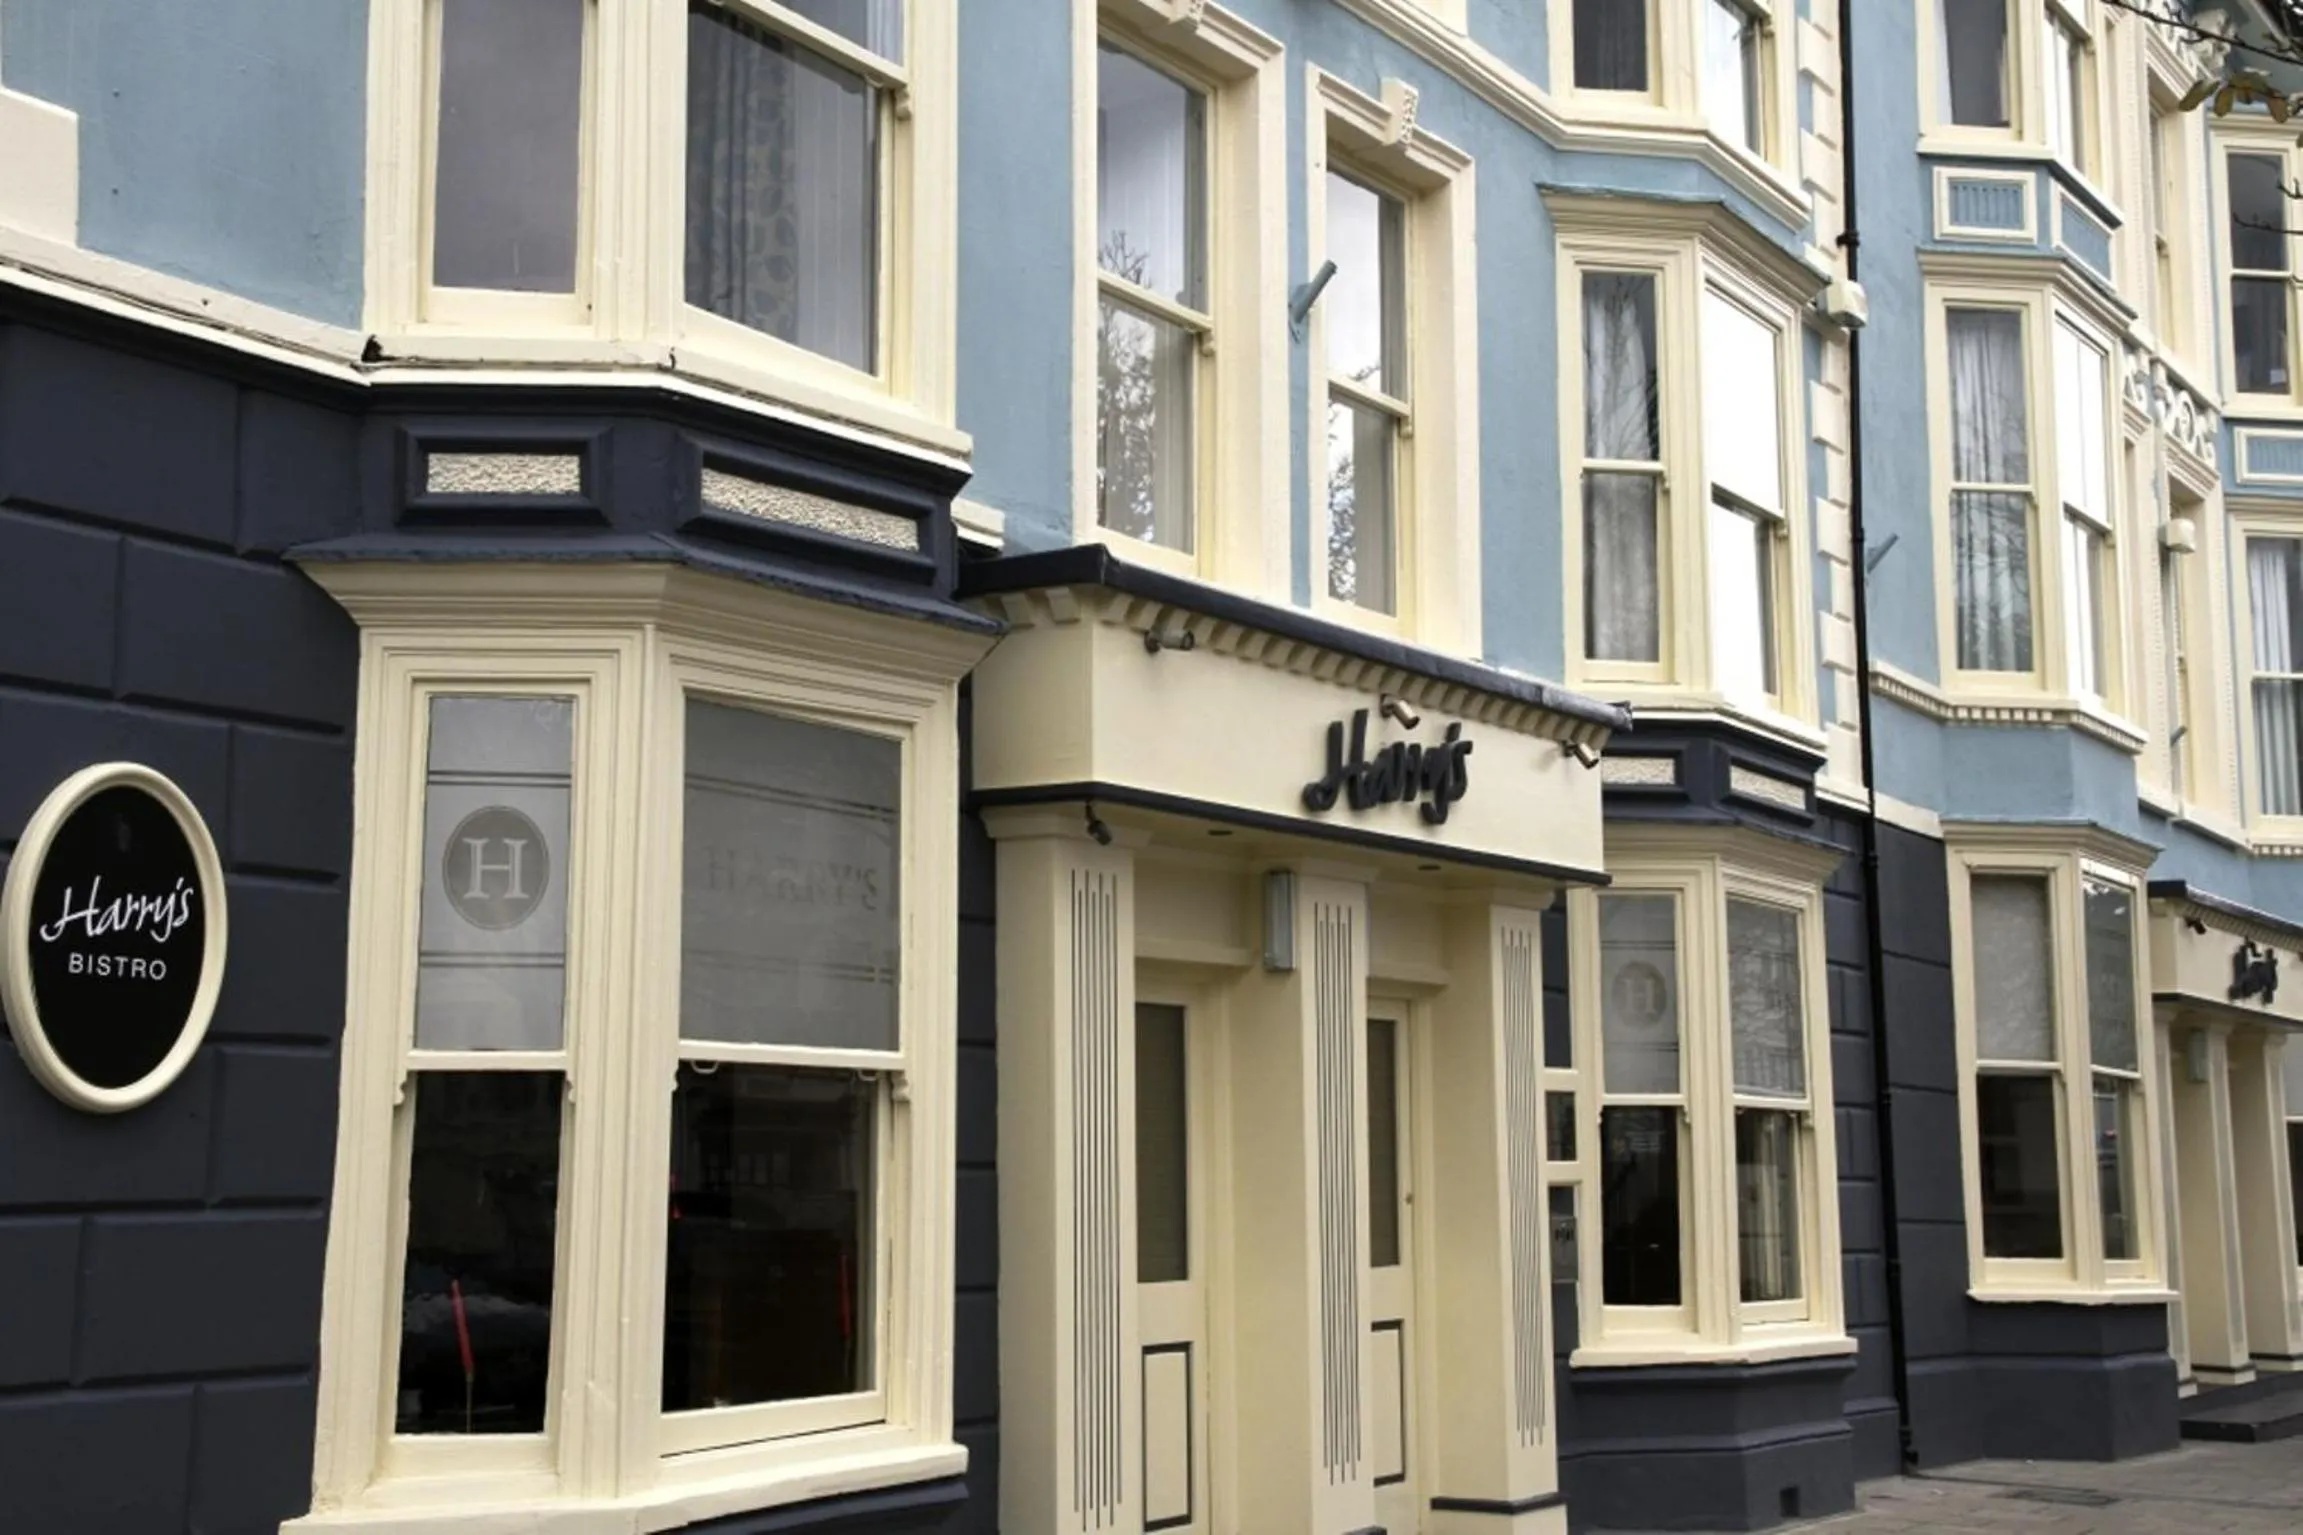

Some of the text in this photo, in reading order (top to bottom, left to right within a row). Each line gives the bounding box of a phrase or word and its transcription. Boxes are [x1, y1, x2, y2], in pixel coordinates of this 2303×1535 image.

[1301, 709, 1473, 825] Harry's
[461, 837, 530, 900] H
[40, 875, 194, 943] Harry's
[68, 952, 167, 981] BISTRO
[1620, 978, 1657, 1013] H
